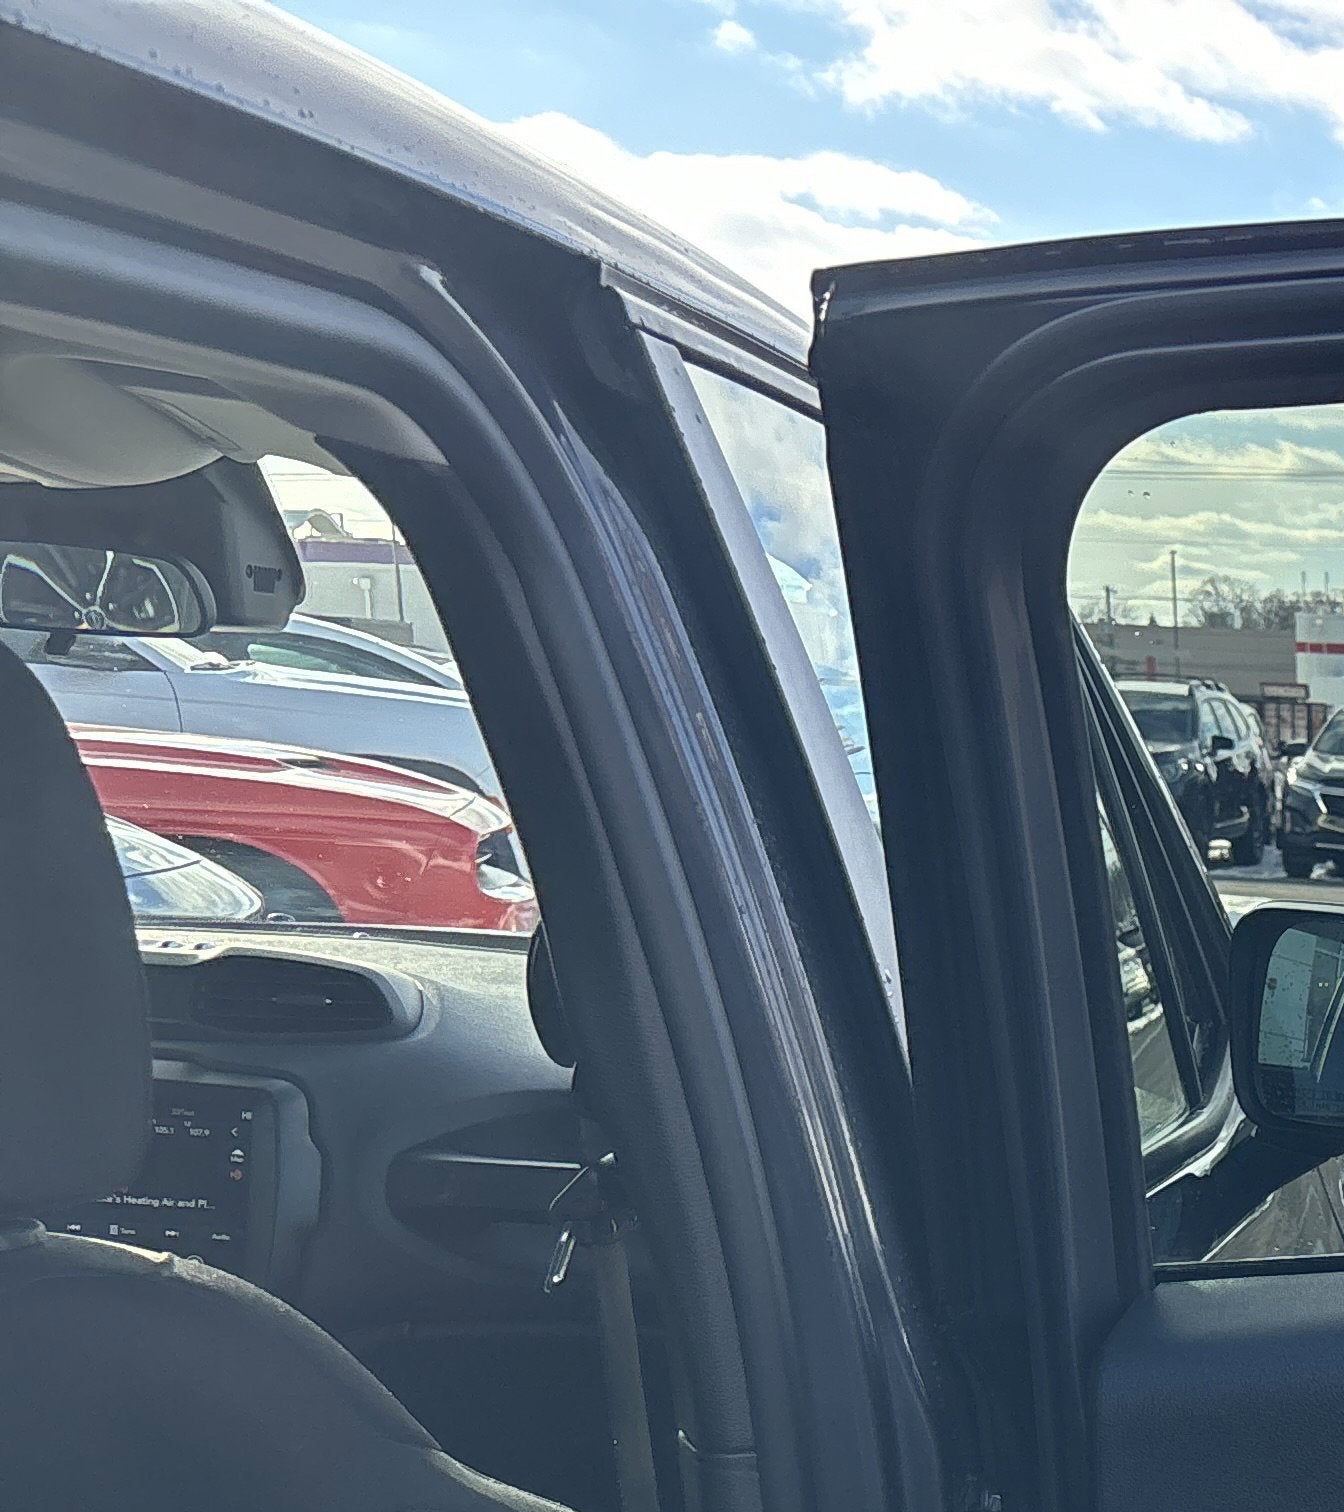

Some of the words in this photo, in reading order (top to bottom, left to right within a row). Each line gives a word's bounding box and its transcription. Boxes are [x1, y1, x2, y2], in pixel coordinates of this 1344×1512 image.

[123, 1195, 160, 1208] Heating
[162, 1197, 175, 1208] Air
[178, 1199, 196, 1209] and
